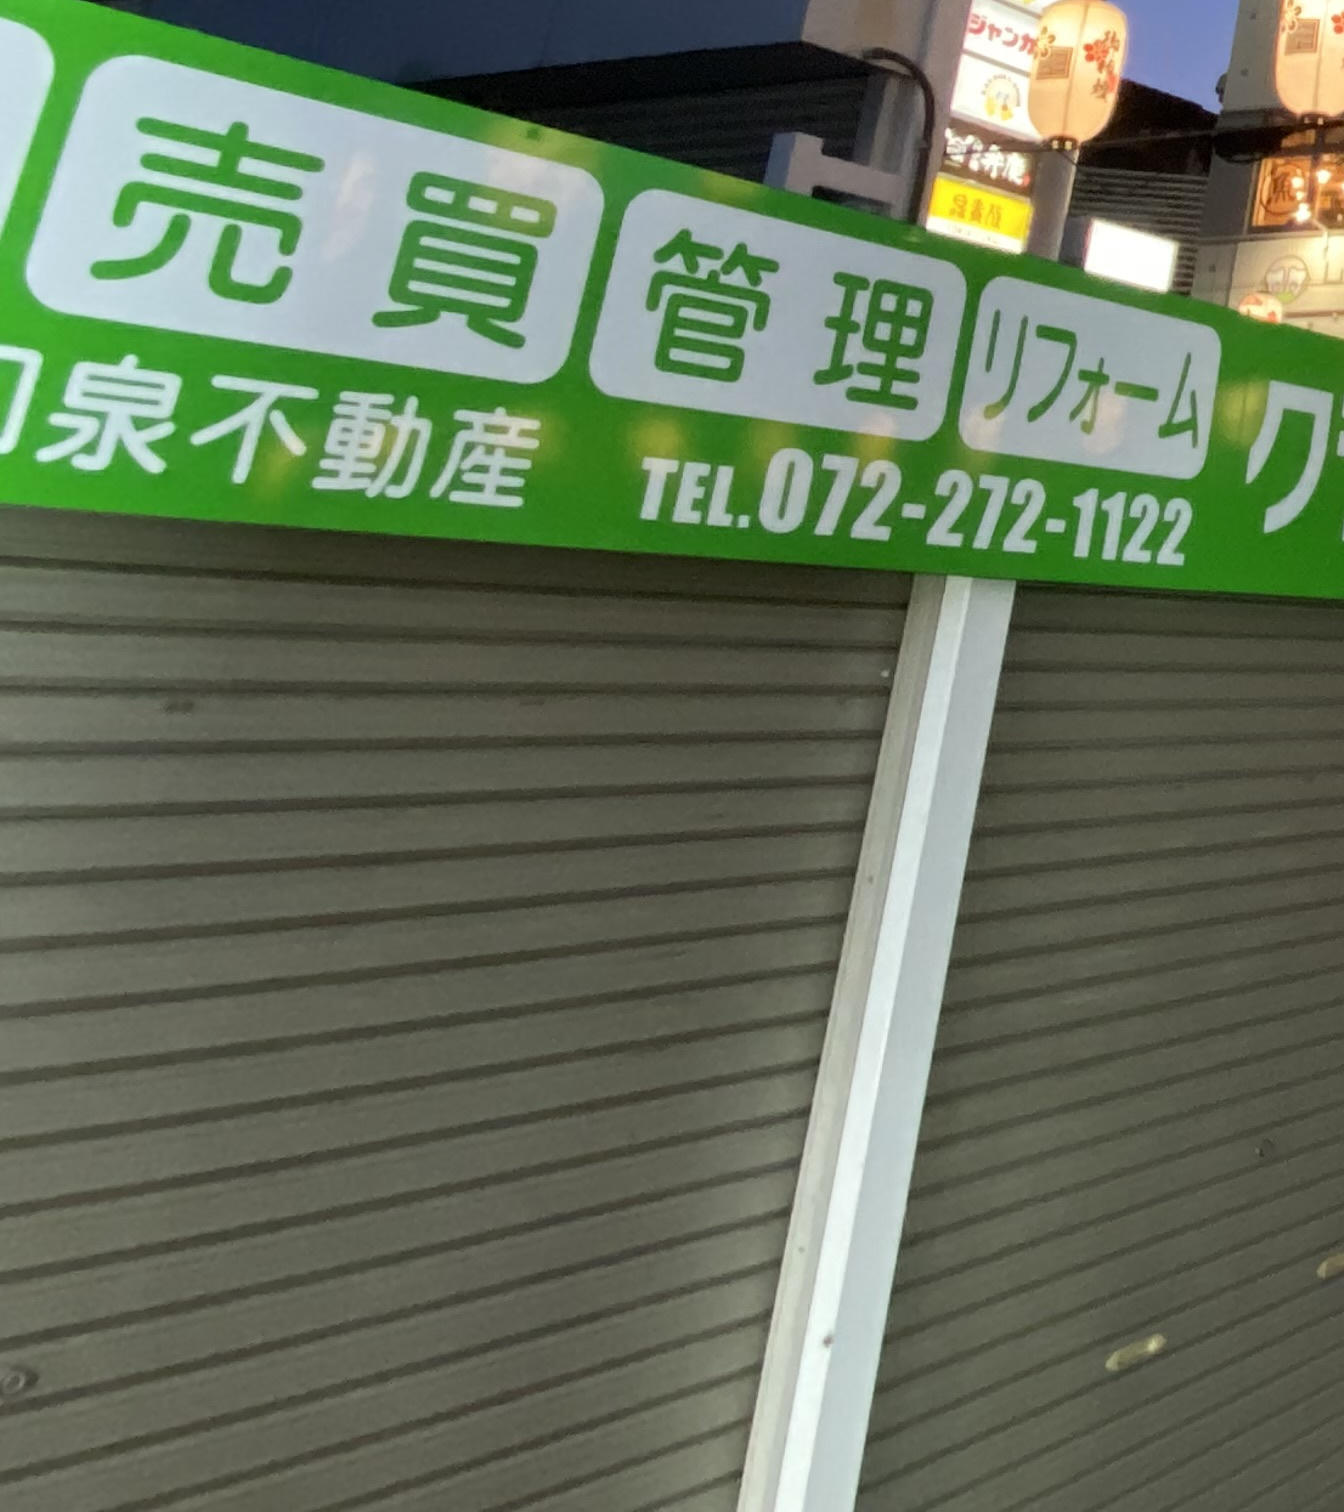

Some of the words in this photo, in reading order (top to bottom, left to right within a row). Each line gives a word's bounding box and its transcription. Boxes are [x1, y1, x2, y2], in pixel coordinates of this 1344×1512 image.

[967, 12, 1039, 57] ジャンカ
[91, 116, 558, 349] 売買
[645, 227, 934, 412] 管理
[980, 309, 1200, 450] リフォーム
[640, 448, 1193, 567] TEL.072-272-1122
